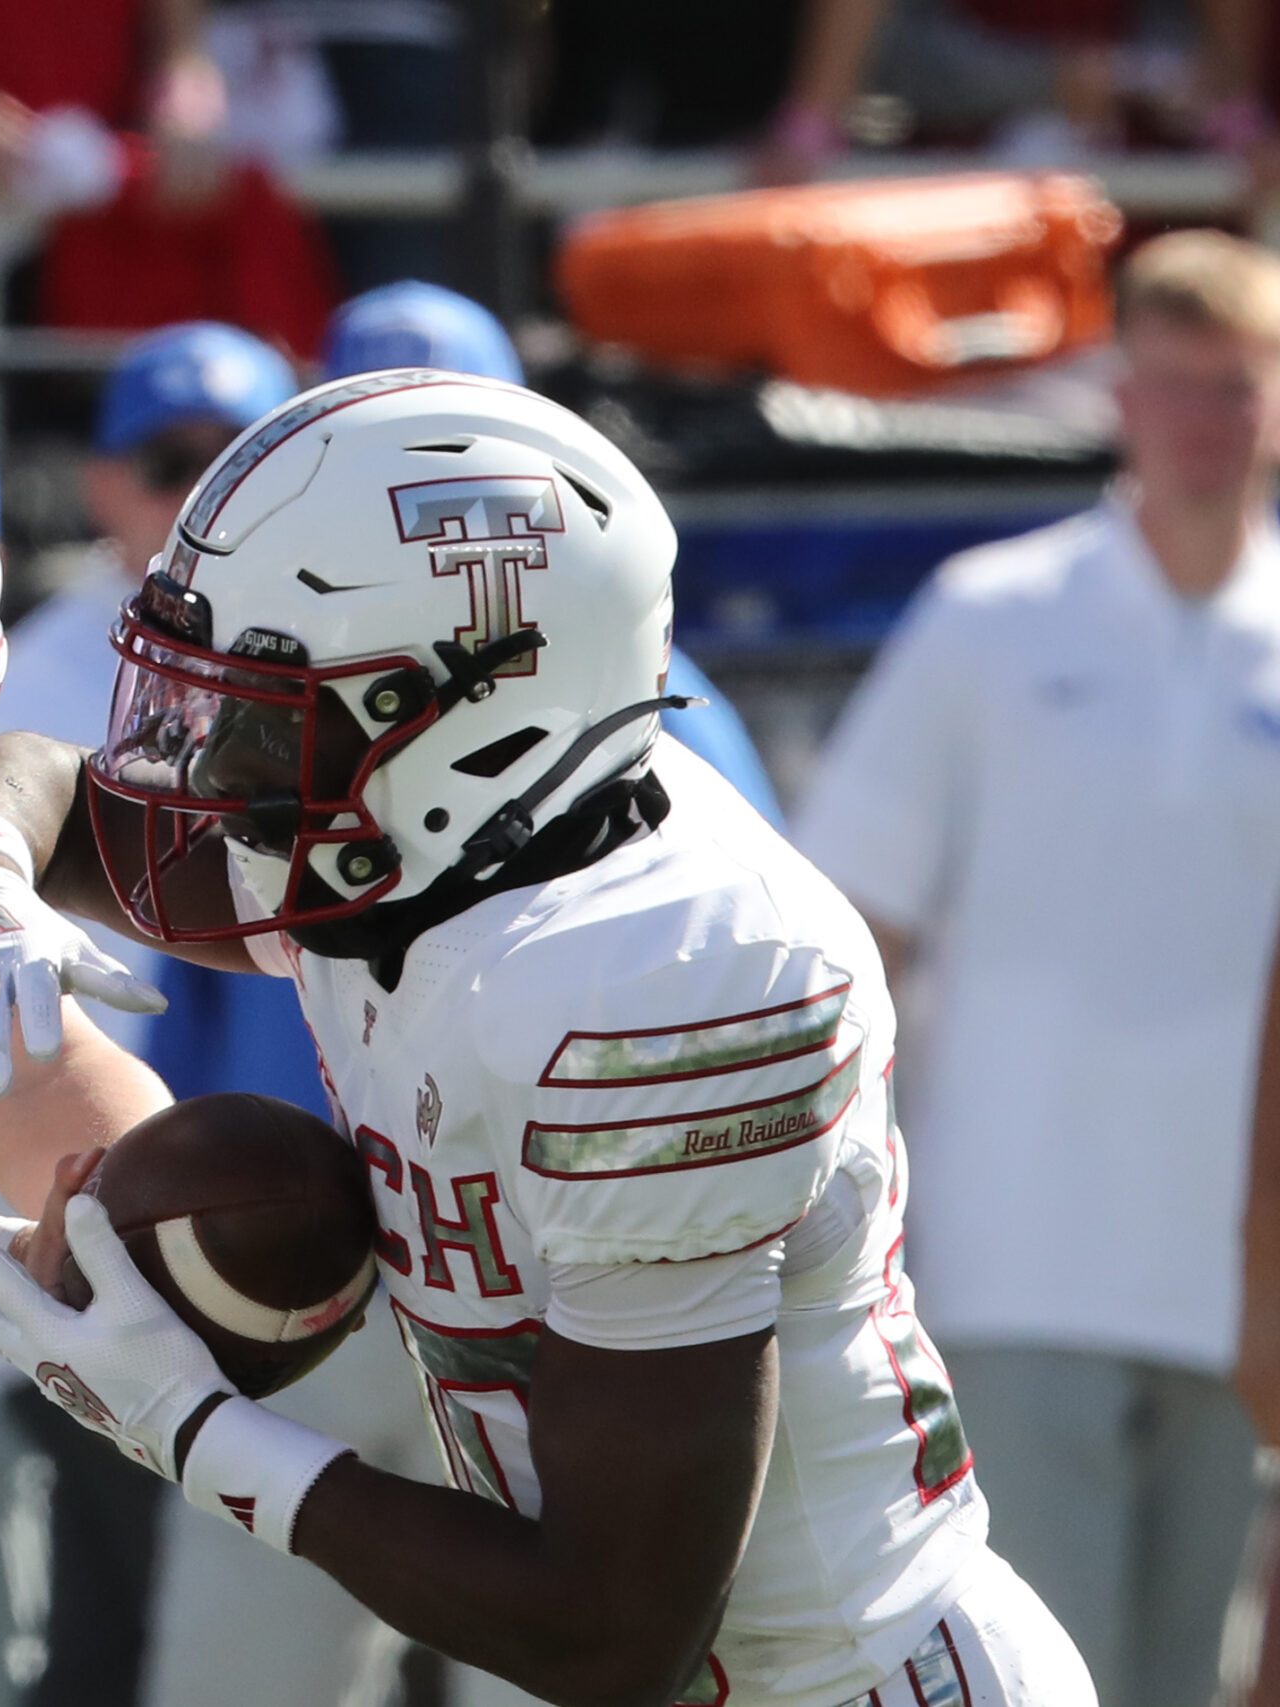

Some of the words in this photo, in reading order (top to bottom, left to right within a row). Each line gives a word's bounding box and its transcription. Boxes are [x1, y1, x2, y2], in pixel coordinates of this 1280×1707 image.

[244, 630, 278, 652] GUNS
[280, 638, 299, 655] UP
[682, 1126, 733, 1156] Red
[737, 1107, 819, 1147] Raiders
